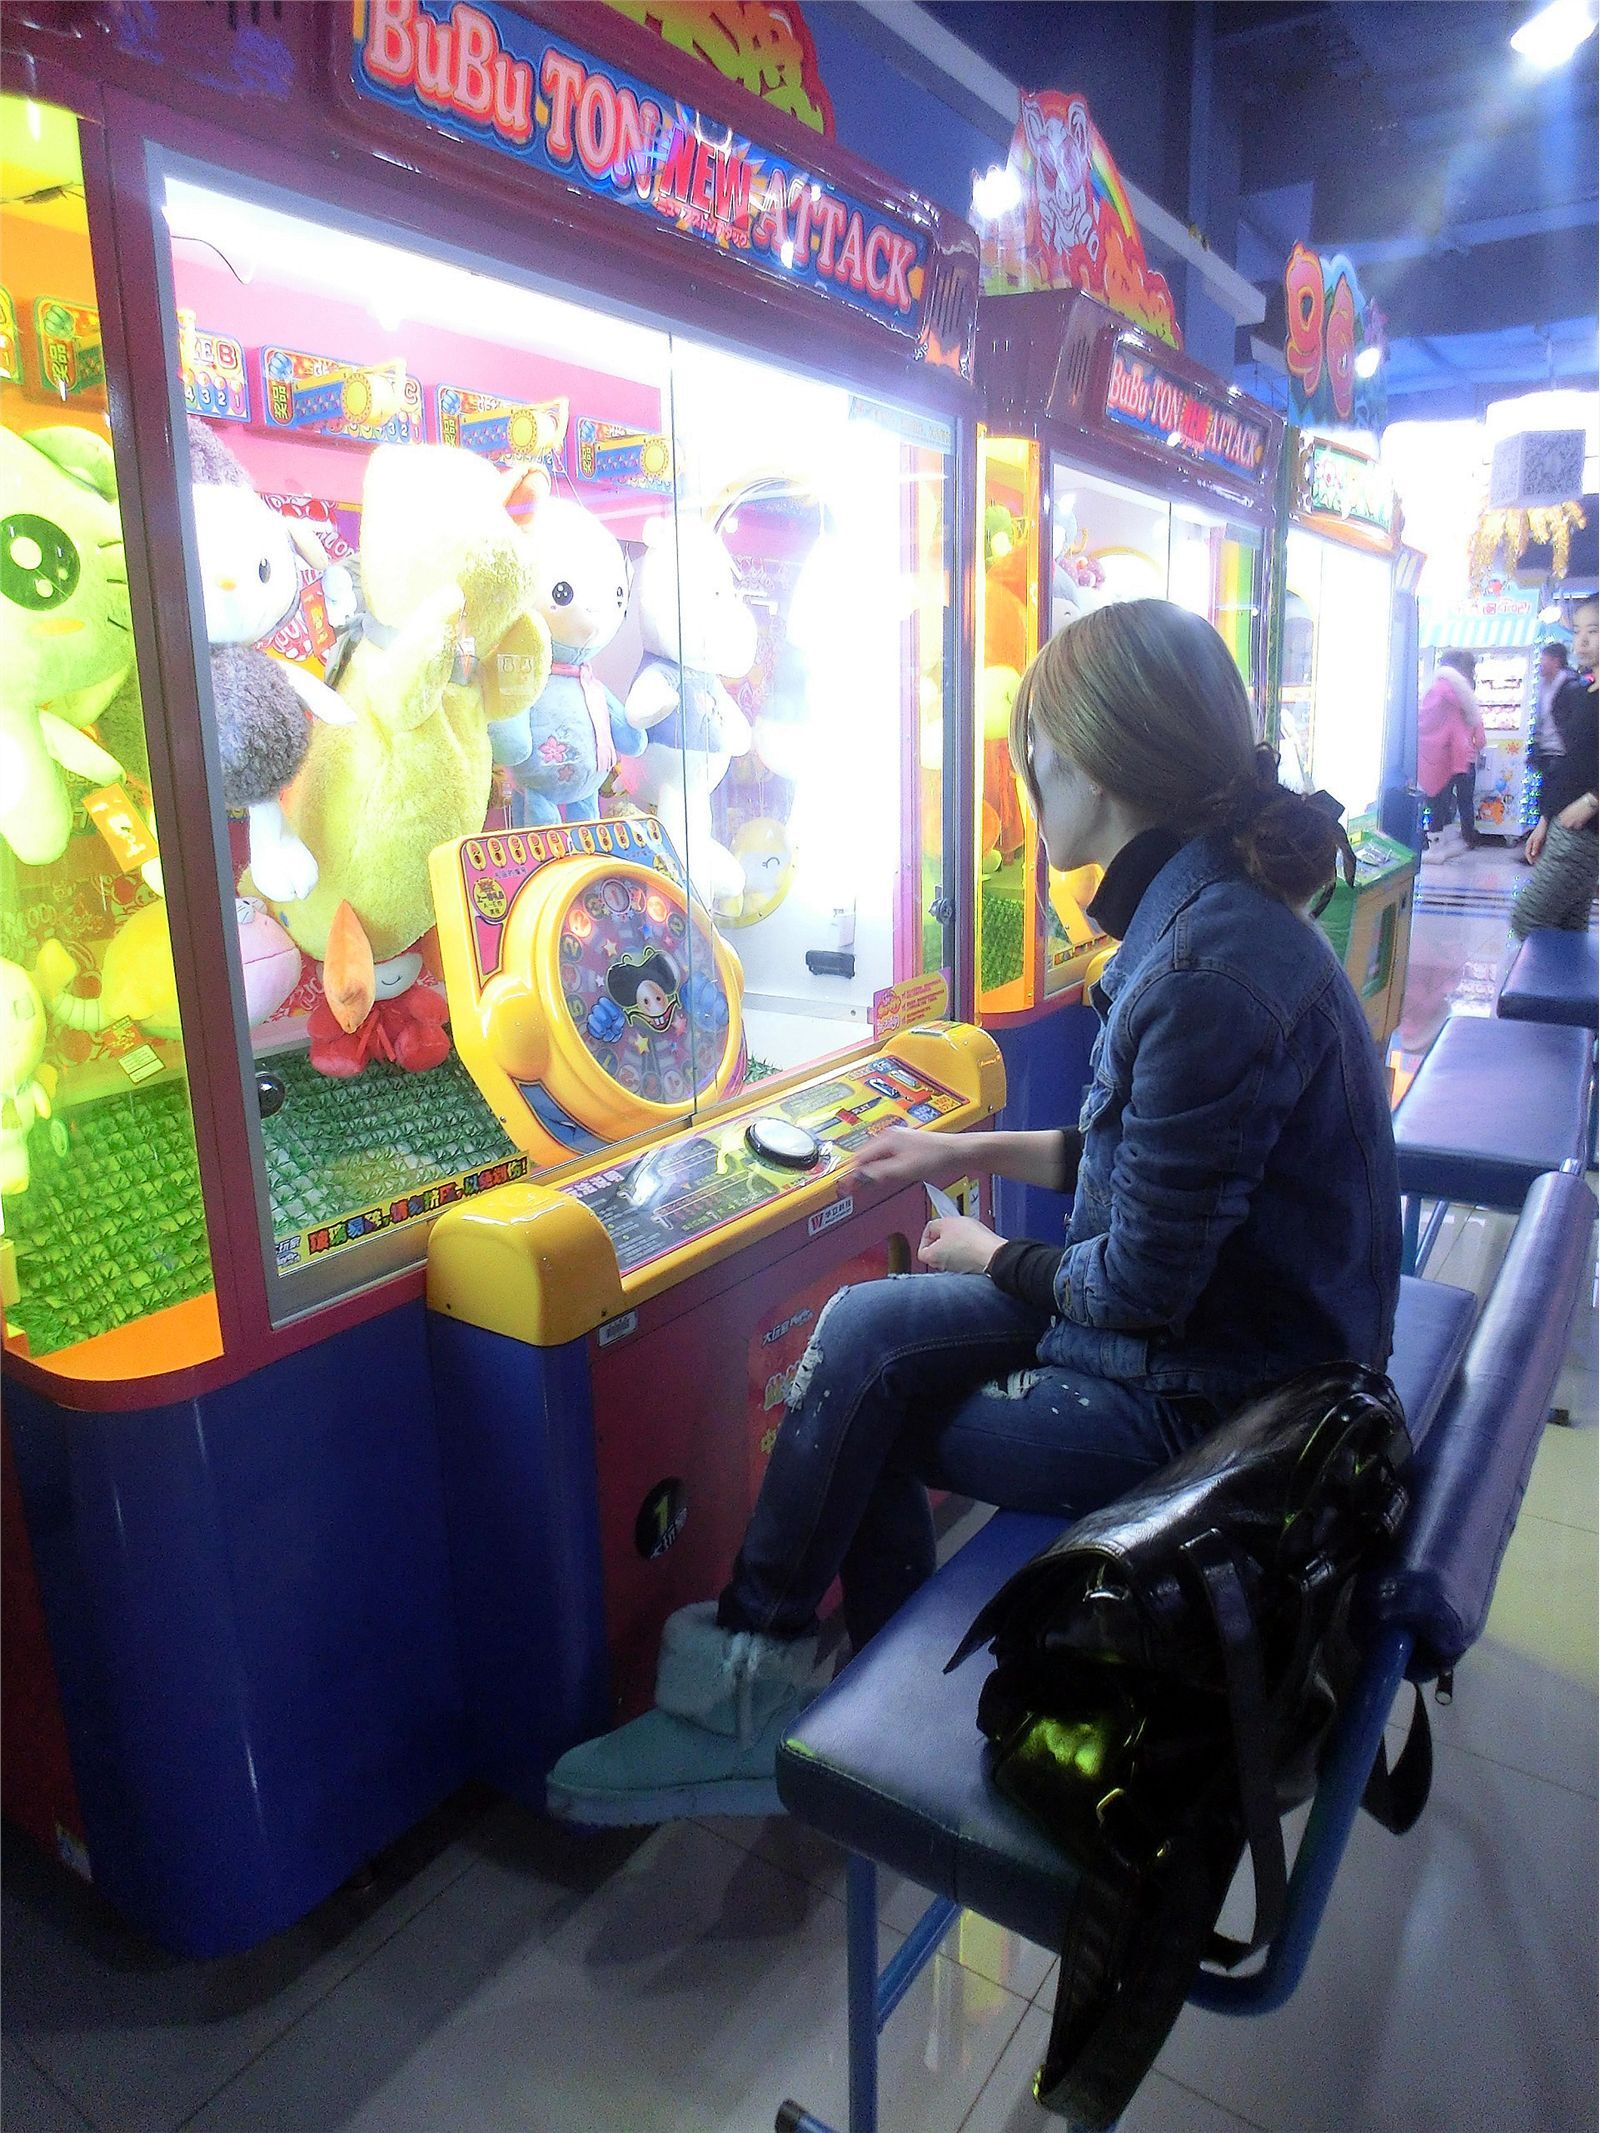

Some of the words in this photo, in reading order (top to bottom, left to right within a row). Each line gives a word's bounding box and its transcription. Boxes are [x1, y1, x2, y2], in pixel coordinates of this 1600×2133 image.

[365, 0, 533, 139] BuBu
[660, 127, 750, 231] NEW
[753, 168, 917, 313] ATTACK
[217, 342, 237, 369] B
[1108, 358, 1149, 420] BuBu
